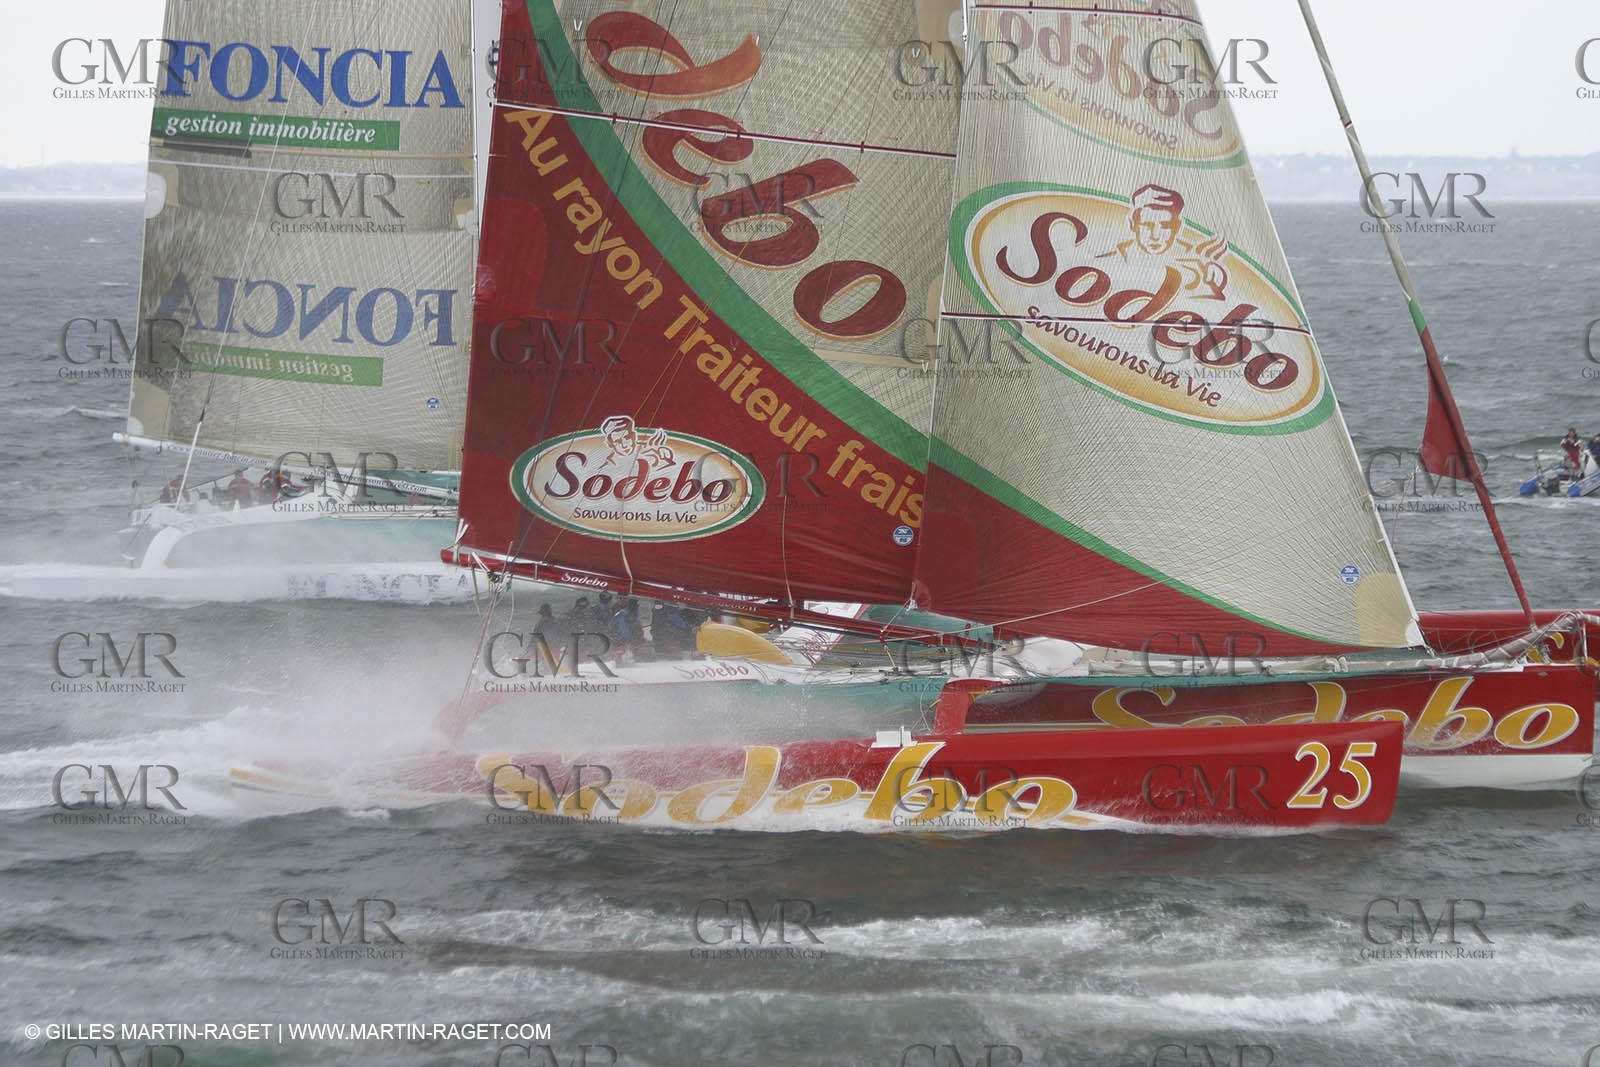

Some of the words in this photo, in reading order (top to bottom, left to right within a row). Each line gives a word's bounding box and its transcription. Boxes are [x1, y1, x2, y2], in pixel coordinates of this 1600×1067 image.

[160, 39, 465, 108] FONCIA
[165, 113, 243, 136] gestion
[249, 117, 376, 144] immobilière
[503, 109, 568, 177] Au
[553, 176, 664, 310] rayon
[663, 294, 827, 452] Traiteur
[826, 439, 926, 529] frais
[995, 211, 1300, 394] Sodebo
[1153, 360, 1180, 390] la
[544, 452, 734, 504] Sodebo
[656, 510, 672, 522] la
[675, 511, 697, 523] Vie
[561, 572, 608, 587] Sodebo
[1287, 742, 1377, 810] 25
